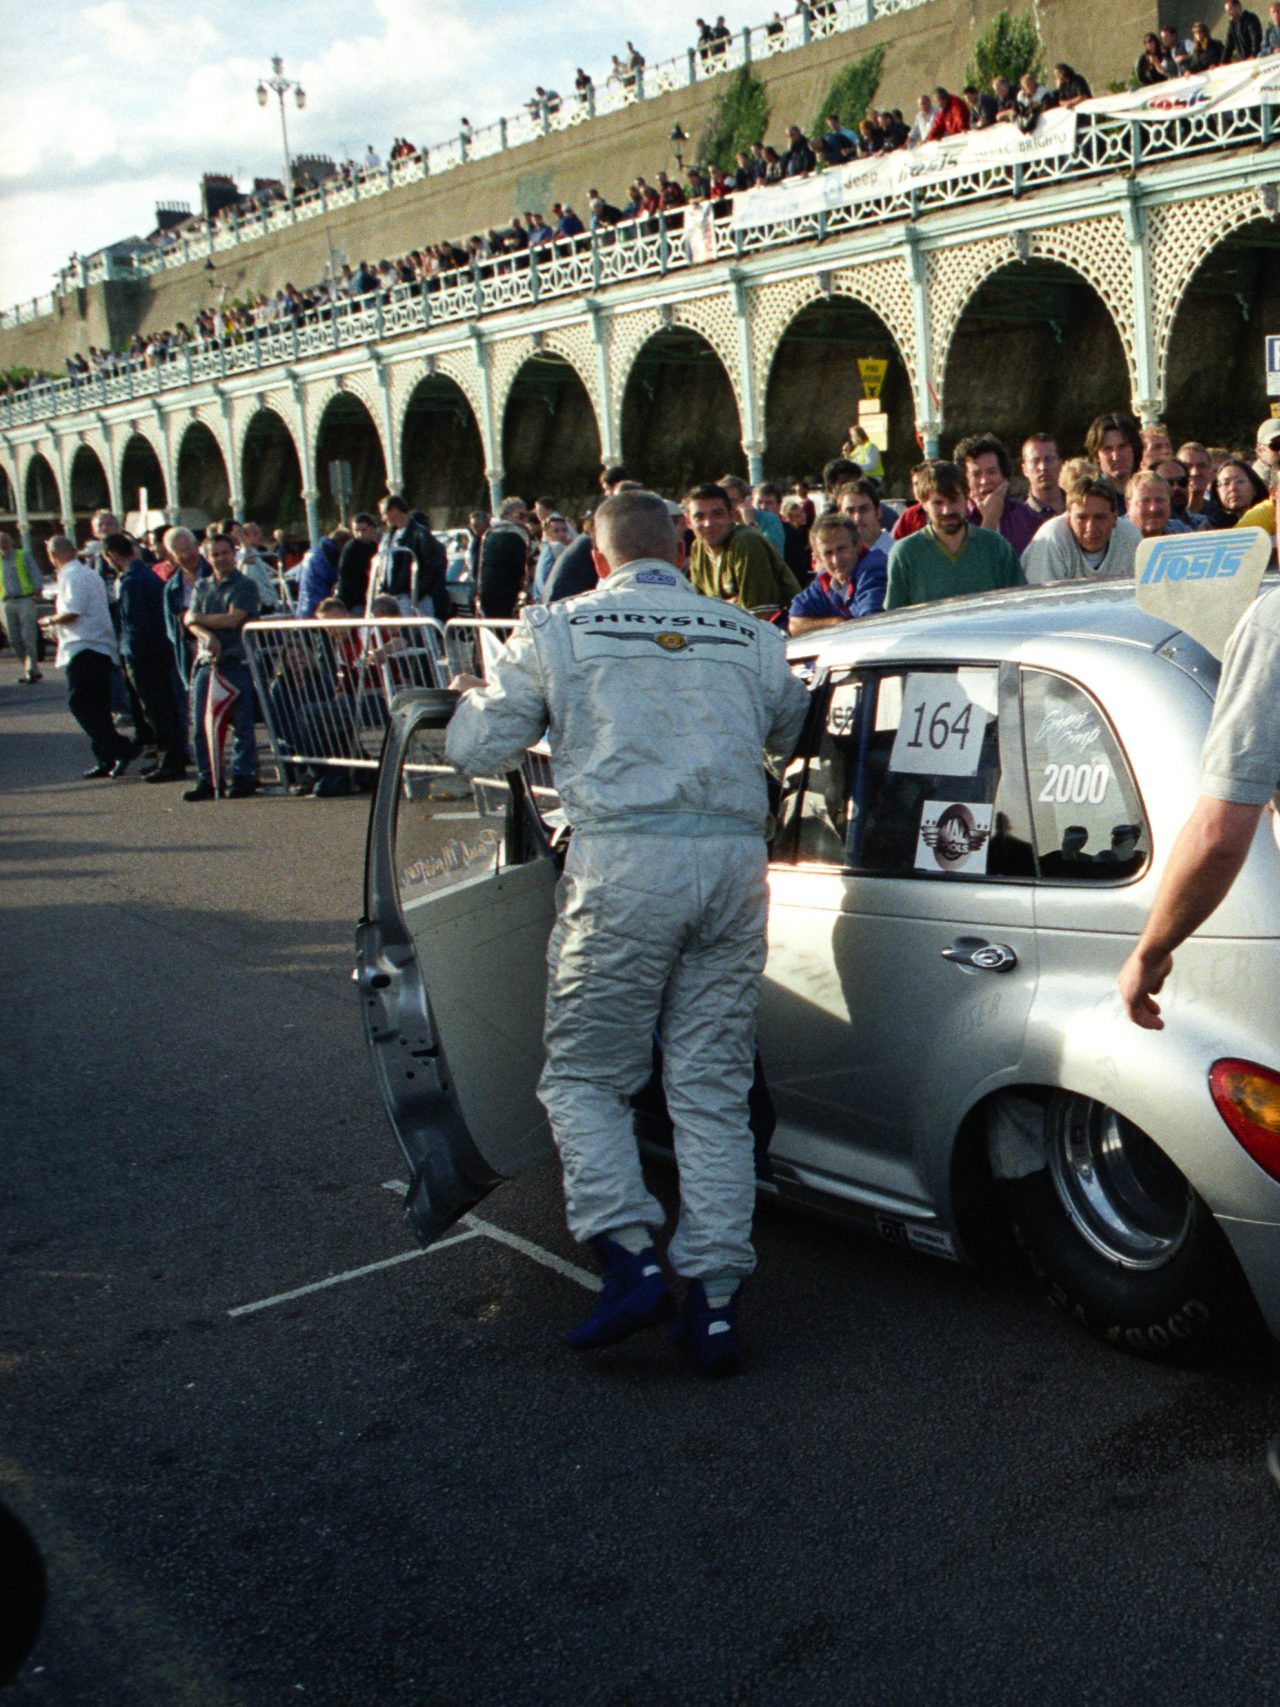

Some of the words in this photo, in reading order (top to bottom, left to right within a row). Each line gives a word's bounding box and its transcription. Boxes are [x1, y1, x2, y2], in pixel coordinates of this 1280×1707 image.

[569, 614, 756, 641] CHRYSLER
[906, 702, 973, 751] 164
[1038, 763, 1110, 804] 2000
